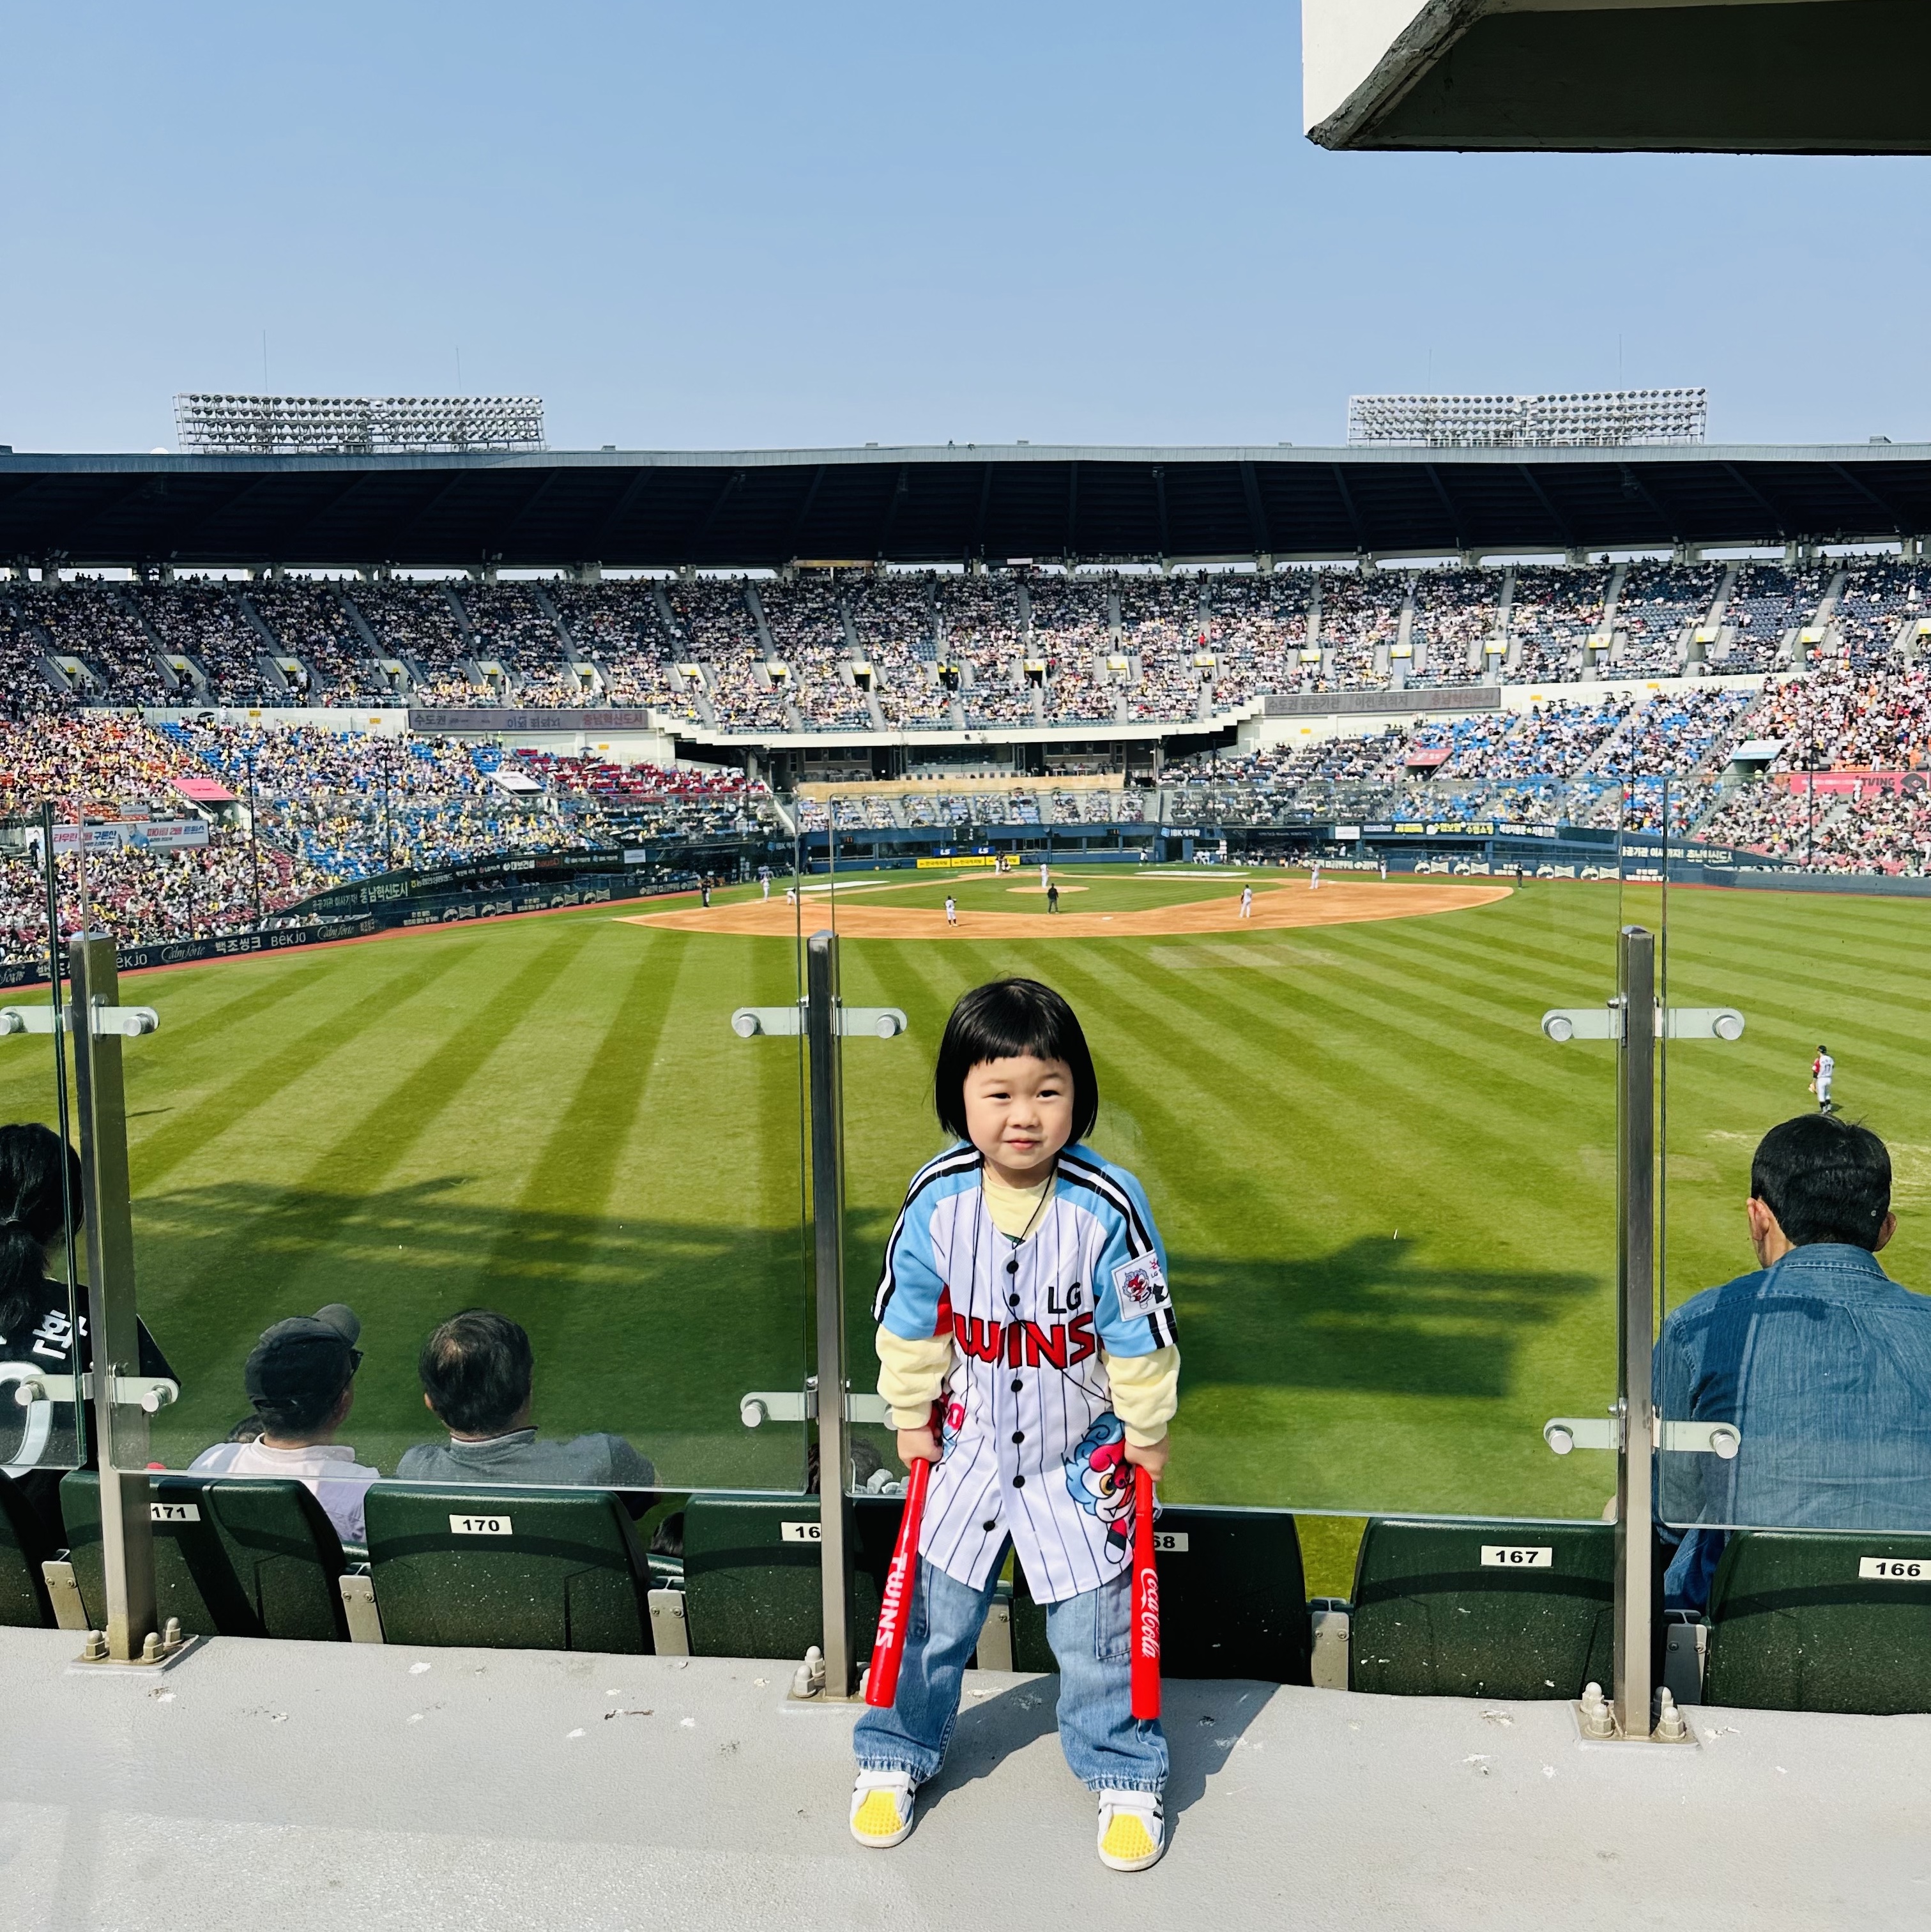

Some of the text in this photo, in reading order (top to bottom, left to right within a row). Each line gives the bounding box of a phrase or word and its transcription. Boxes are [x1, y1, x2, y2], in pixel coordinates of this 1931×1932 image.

[415, 715, 446, 726] 수도권
[583, 713, 643, 726] 충남혁신도시
[1861, 777, 1895, 786] TVING
[54, 833, 77, 842] 타우린
[94, 830, 116, 839] 구론산
[360, 881, 408, 904] 충남혁신도시
[215, 936, 262, 953] 백조씽크
[1048, 1282, 1081, 1314] LG
[949, 1310, 1096, 1371] WINS
[152, 1506, 186, 1519] 171
[462, 1518, 500, 1532] 170
[795, 1525, 821, 1539] 16
[1154, 1535, 1176, 1549] 68
[1495, 1549, 1539, 1564] 167
[1875, 1562, 1921, 1577] 166
[876, 1552, 908, 1648] TWINS
